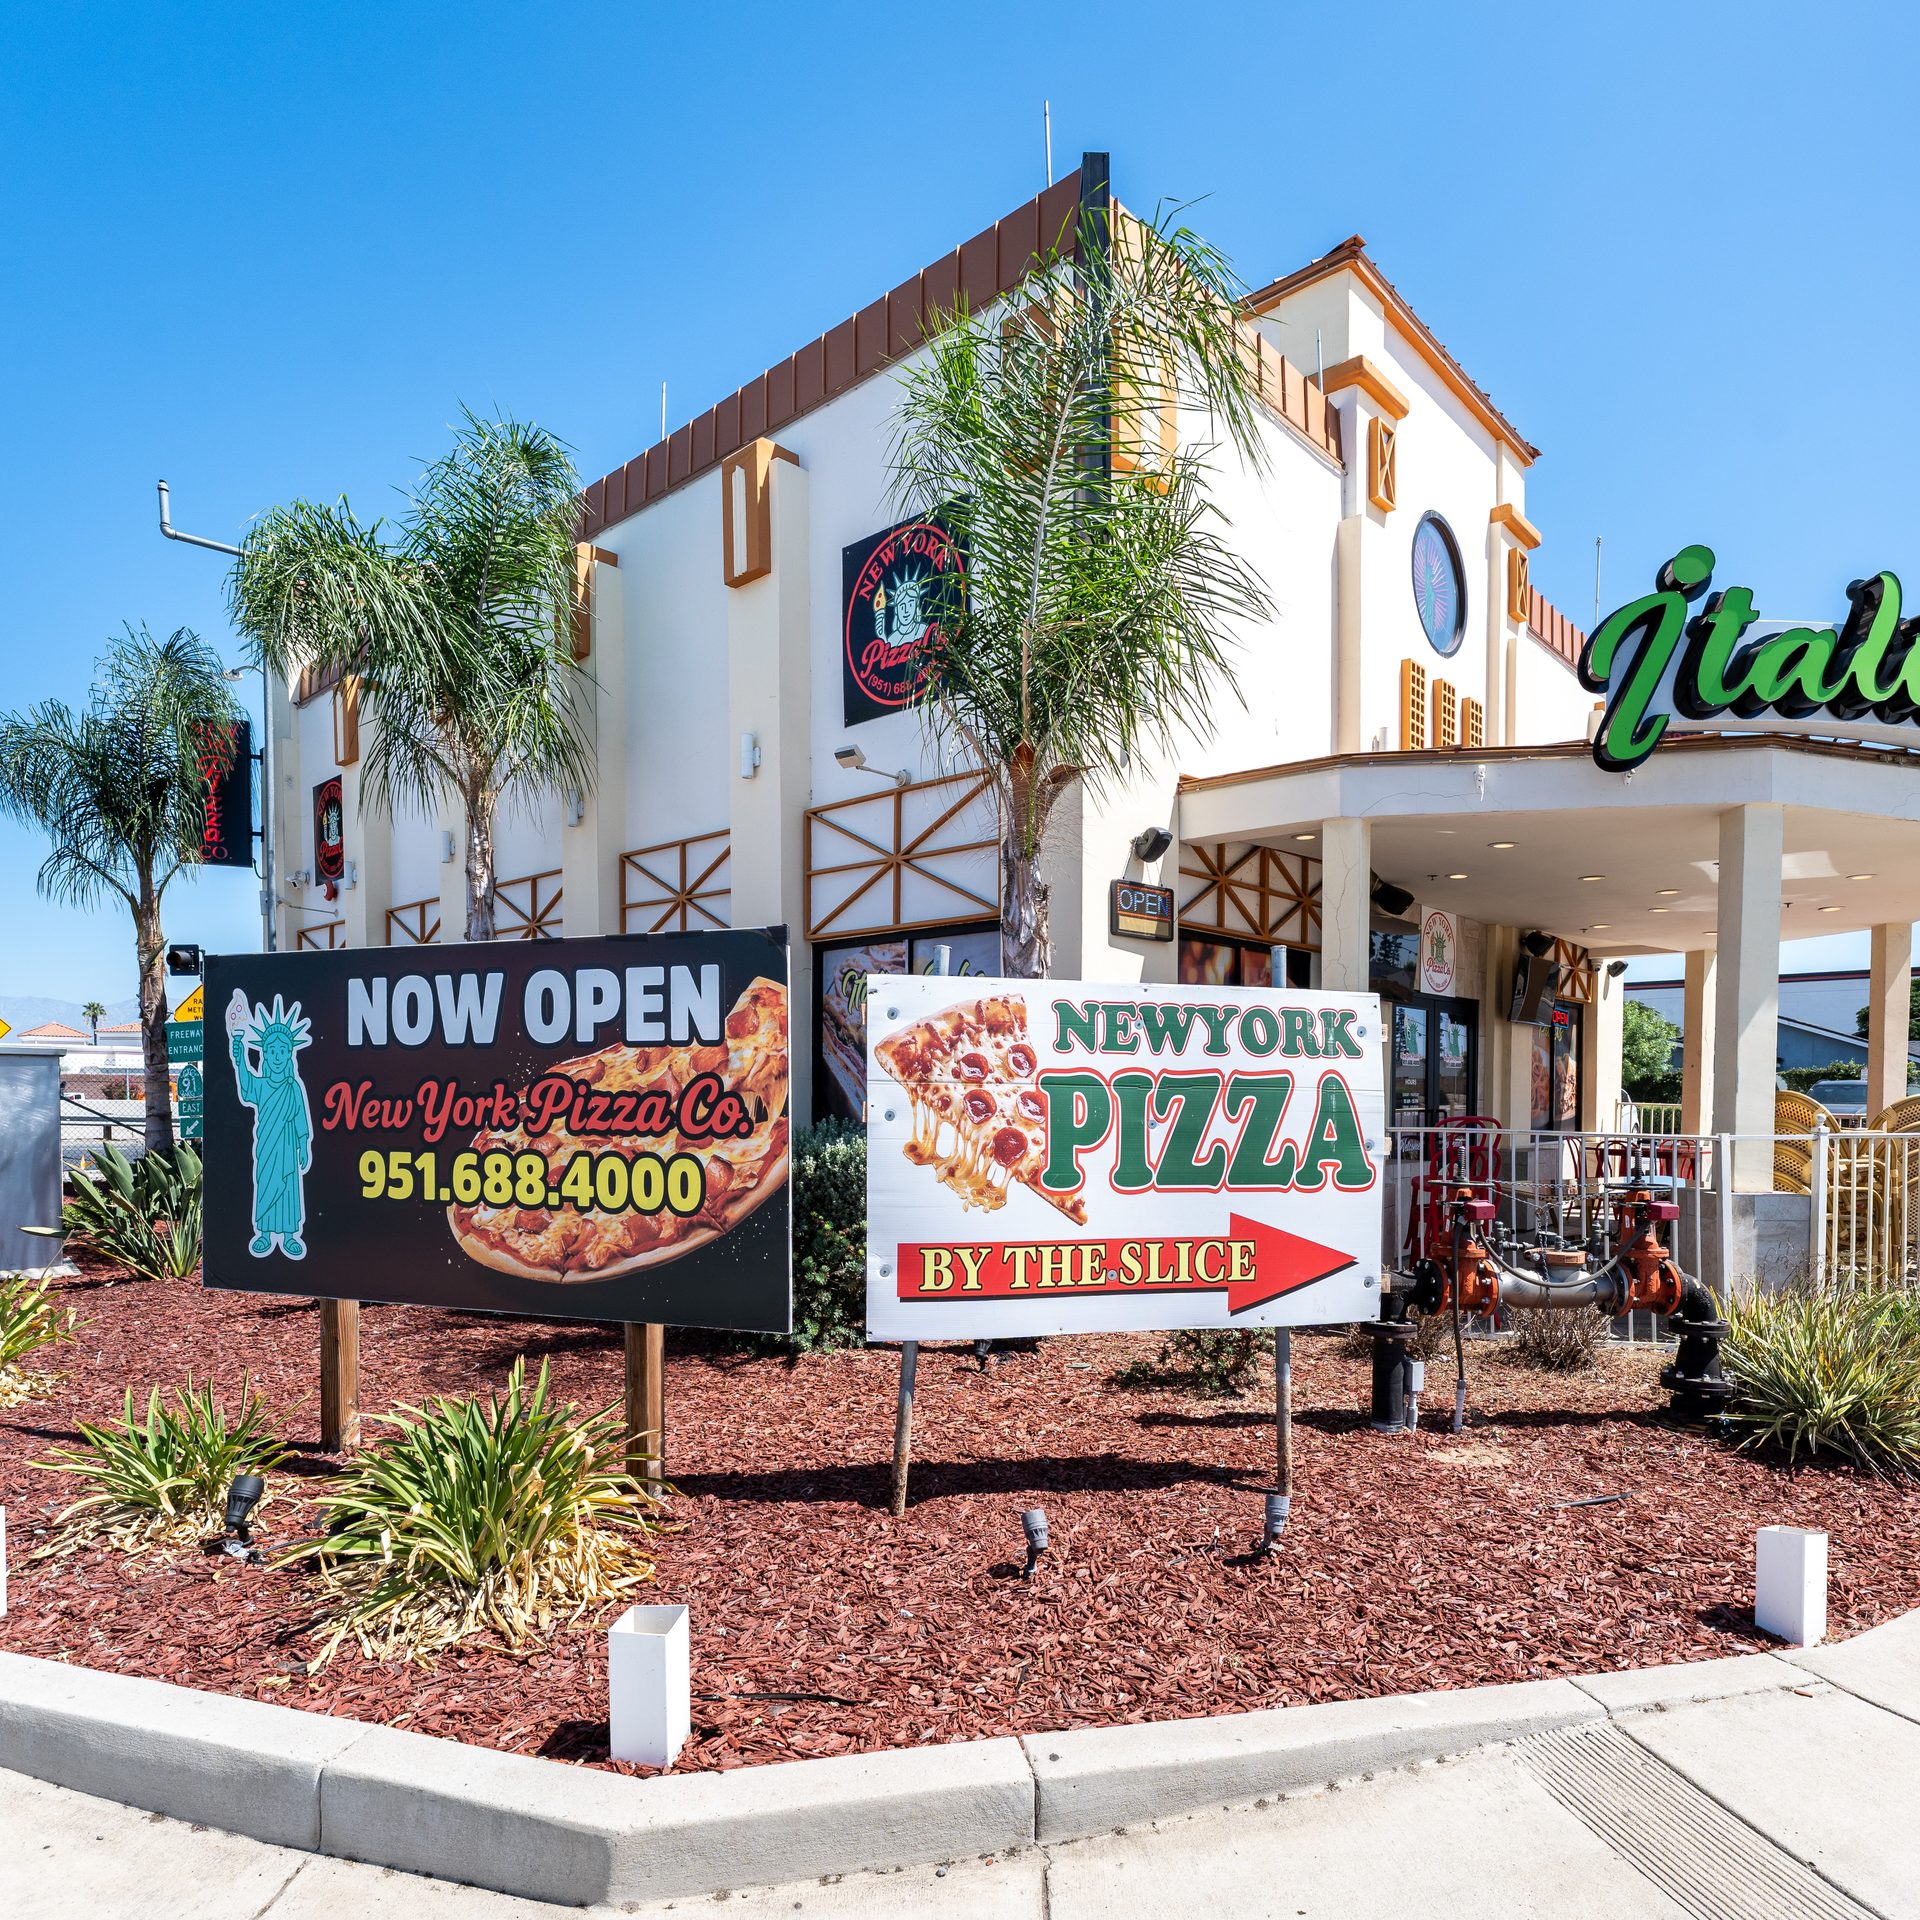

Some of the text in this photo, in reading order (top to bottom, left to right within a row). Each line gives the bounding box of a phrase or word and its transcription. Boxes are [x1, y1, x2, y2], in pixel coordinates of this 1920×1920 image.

[859, 540, 896, 601] NEW
[868, 673, 892, 697] (951)
[1119, 889, 1169, 917] OPEN
[348, 964, 720, 1046] NOW OPEN
[182, 1077, 196, 1092] 91
[182, 1102, 200, 1113] EAST
[323, 1078, 754, 1143] New York Pizza Co.
[1036, 1068, 1377, 1194] PIZZA
[359, 1150, 703, 1212] 951.688.4000
[919, 1240, 1257, 1292] BY THE SLICE
